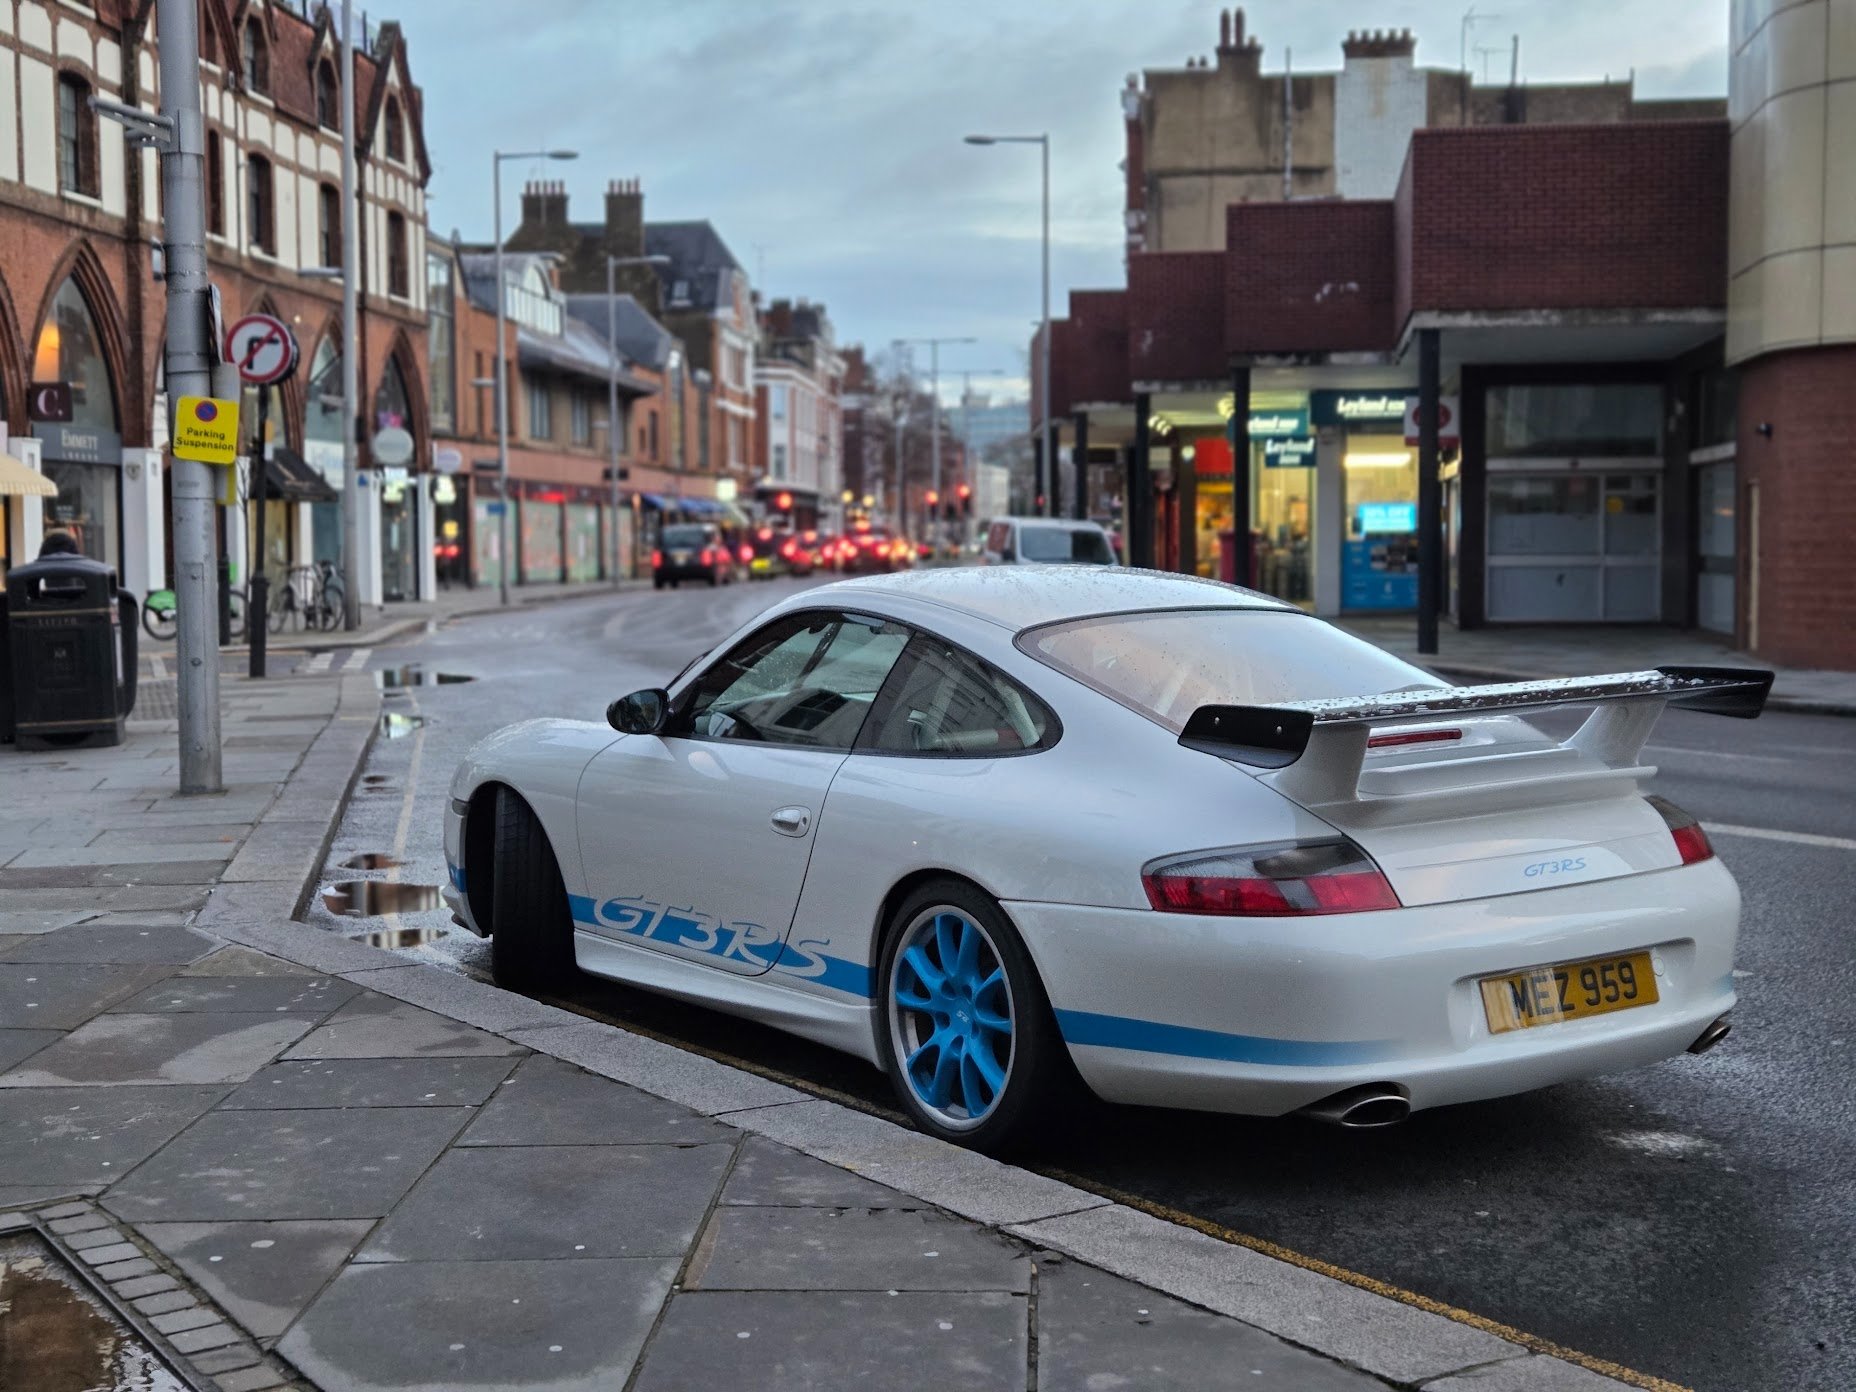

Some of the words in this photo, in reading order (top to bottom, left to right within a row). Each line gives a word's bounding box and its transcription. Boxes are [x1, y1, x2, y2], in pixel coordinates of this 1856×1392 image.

[186, 427, 225, 441] Parking
[176, 437, 234, 451] Suspension
[1510, 973, 1575, 1019] MEZ
[1580, 961, 1638, 1006] 959
